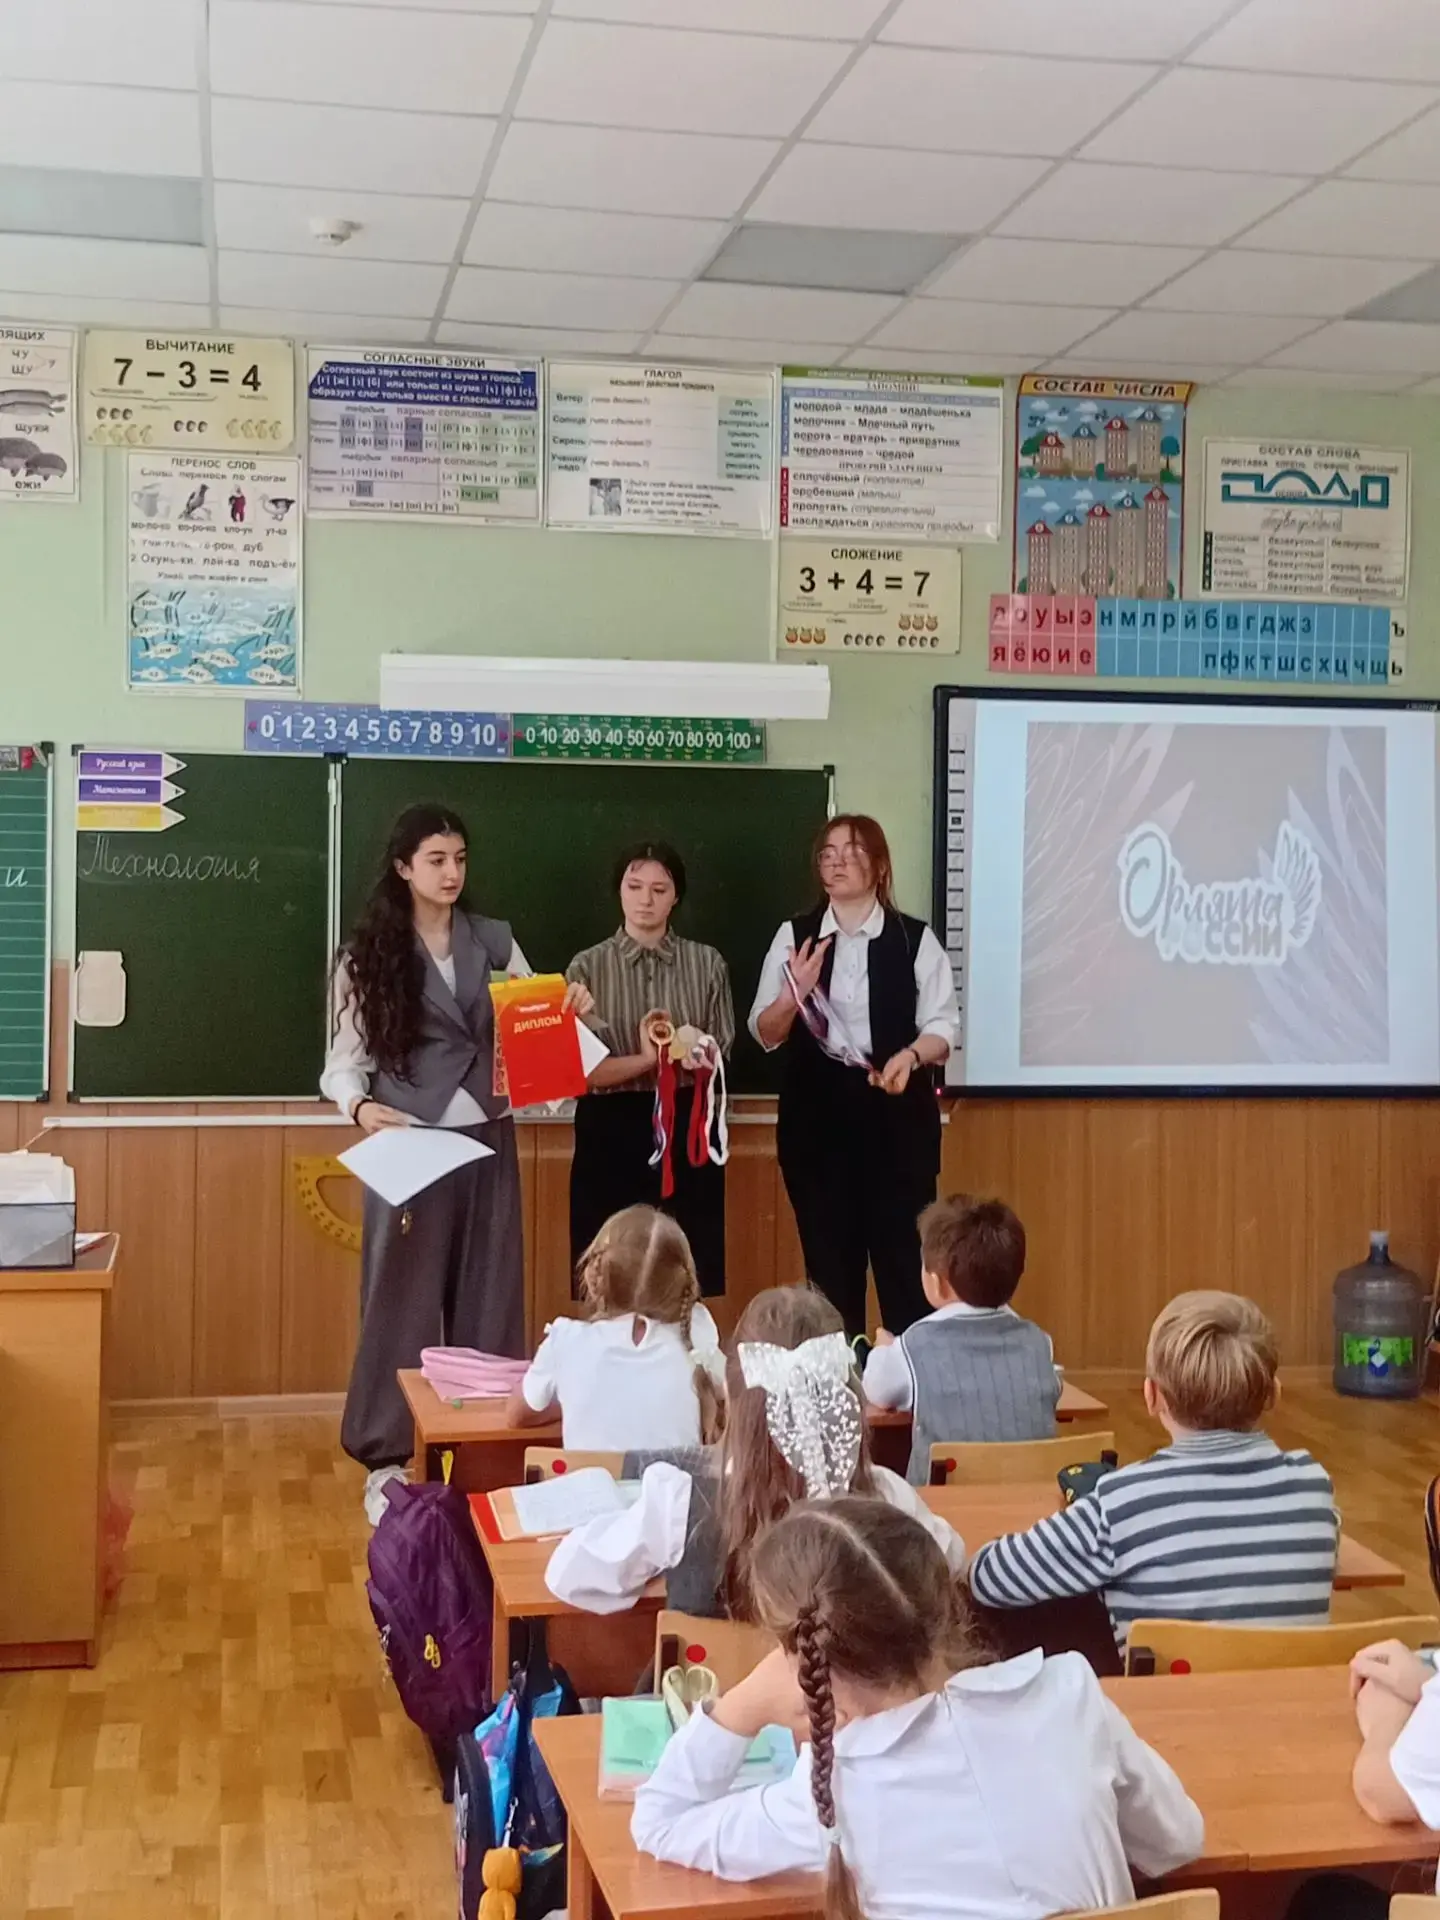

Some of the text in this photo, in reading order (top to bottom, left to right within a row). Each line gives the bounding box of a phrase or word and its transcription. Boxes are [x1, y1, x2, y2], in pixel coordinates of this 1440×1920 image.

[146, 339, 235, 354] ВЫЧИТАНИЕ
[364, 352, 485, 369] СОГЛАСНЫЕ ЗВУКИ
[113, 358, 133, 386] 7
[178, 361, 197, 389] 3
[242, 364, 262, 391] 4
[644, 369, 682, 379] ГЛАГОЛ
[1033, 379, 1176, 397] СОСТАВ ЧИСЛА
[794, 402, 842, 412] молодой
[1259, 445, 1312, 457] СОСТАВ
[172, 457, 256, 470] ПЕРЕНОС СЛОВ
[243, 542, 264, 553] дуб
[831, 548, 903, 561] СЛОЖЕНИЕ
[800, 567, 816, 593] 3
[856, 569, 874, 595] 4
[913, 571, 931, 597] 7
[1035, 608, 1048, 628] у
[1055, 610, 1073, 623] ы
[1080, 610, 1092, 625] э
[1100, 609, 1113, 623] н
[1121, 611, 1136, 626] м
[1142, 611, 1156, 627] л
[1162, 612, 1176, 633] р
[1184, 610, 1196, 629] й
[1204, 608, 1218, 630] б
[1226, 615, 1239, 630] в
[1246, 615, 1255, 631] г
[1260, 616, 1276, 635] д
[1279, 616, 1296, 633] ж
[1301, 618, 1311, 633] з
[993, 642, 1403, 679] я ё ю и е п ф к т ш с х ц ч щ ь
[261, 715, 496, 746] 0 1 2 3 4 5 6 7 8 9 10
[526, 727, 751, 749] 0 10 20 30 40 50 60 70 80 90 100
[81, 833, 261, 882] Технология
[513, 1014, 562, 1034] ДИПЛОМ
